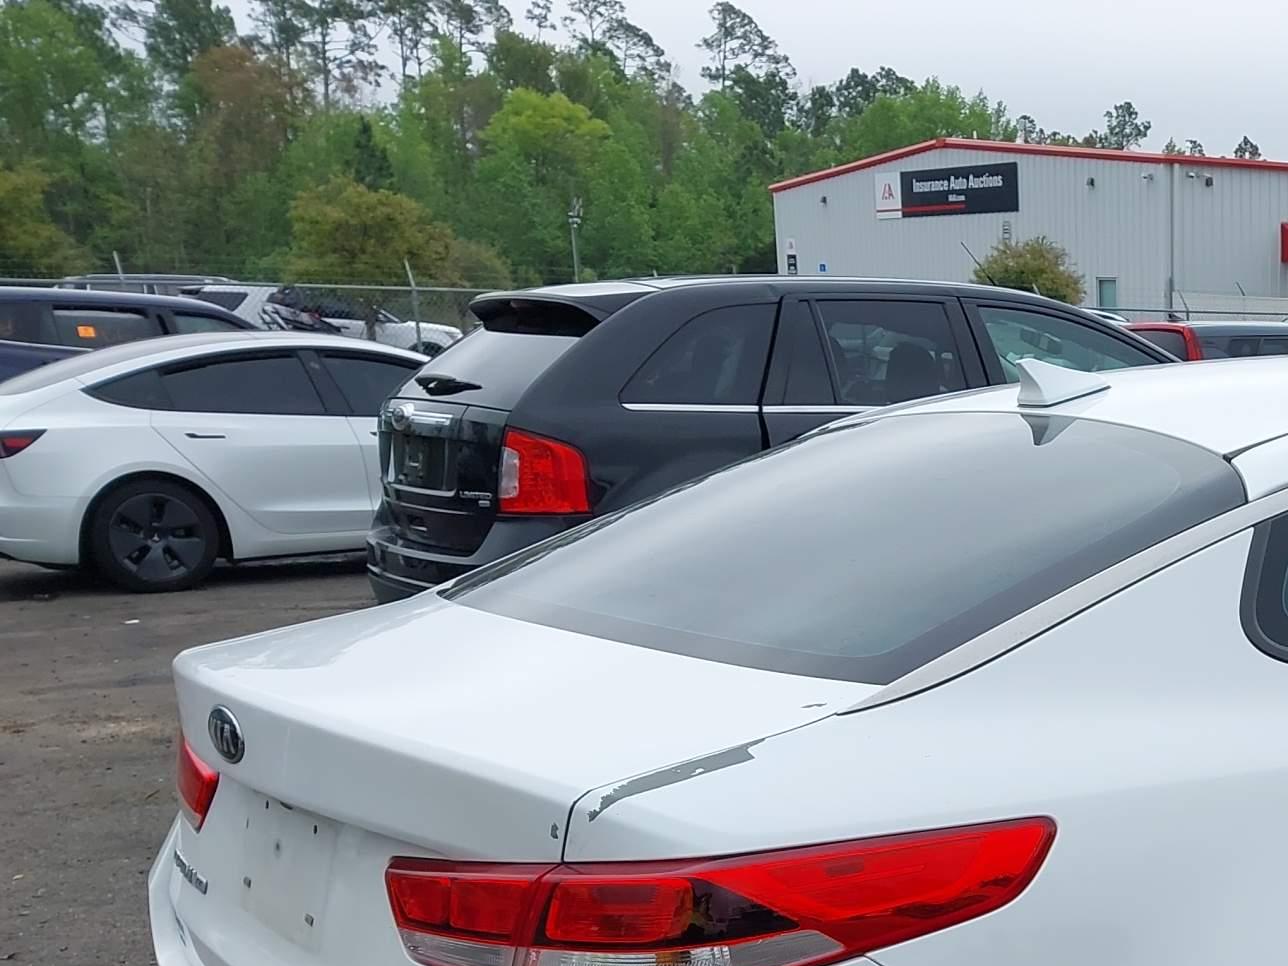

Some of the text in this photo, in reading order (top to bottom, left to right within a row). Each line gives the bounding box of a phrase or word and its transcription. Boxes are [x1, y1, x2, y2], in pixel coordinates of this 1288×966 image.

[912, 173, 1003, 192] Insurance Auto Auctions
